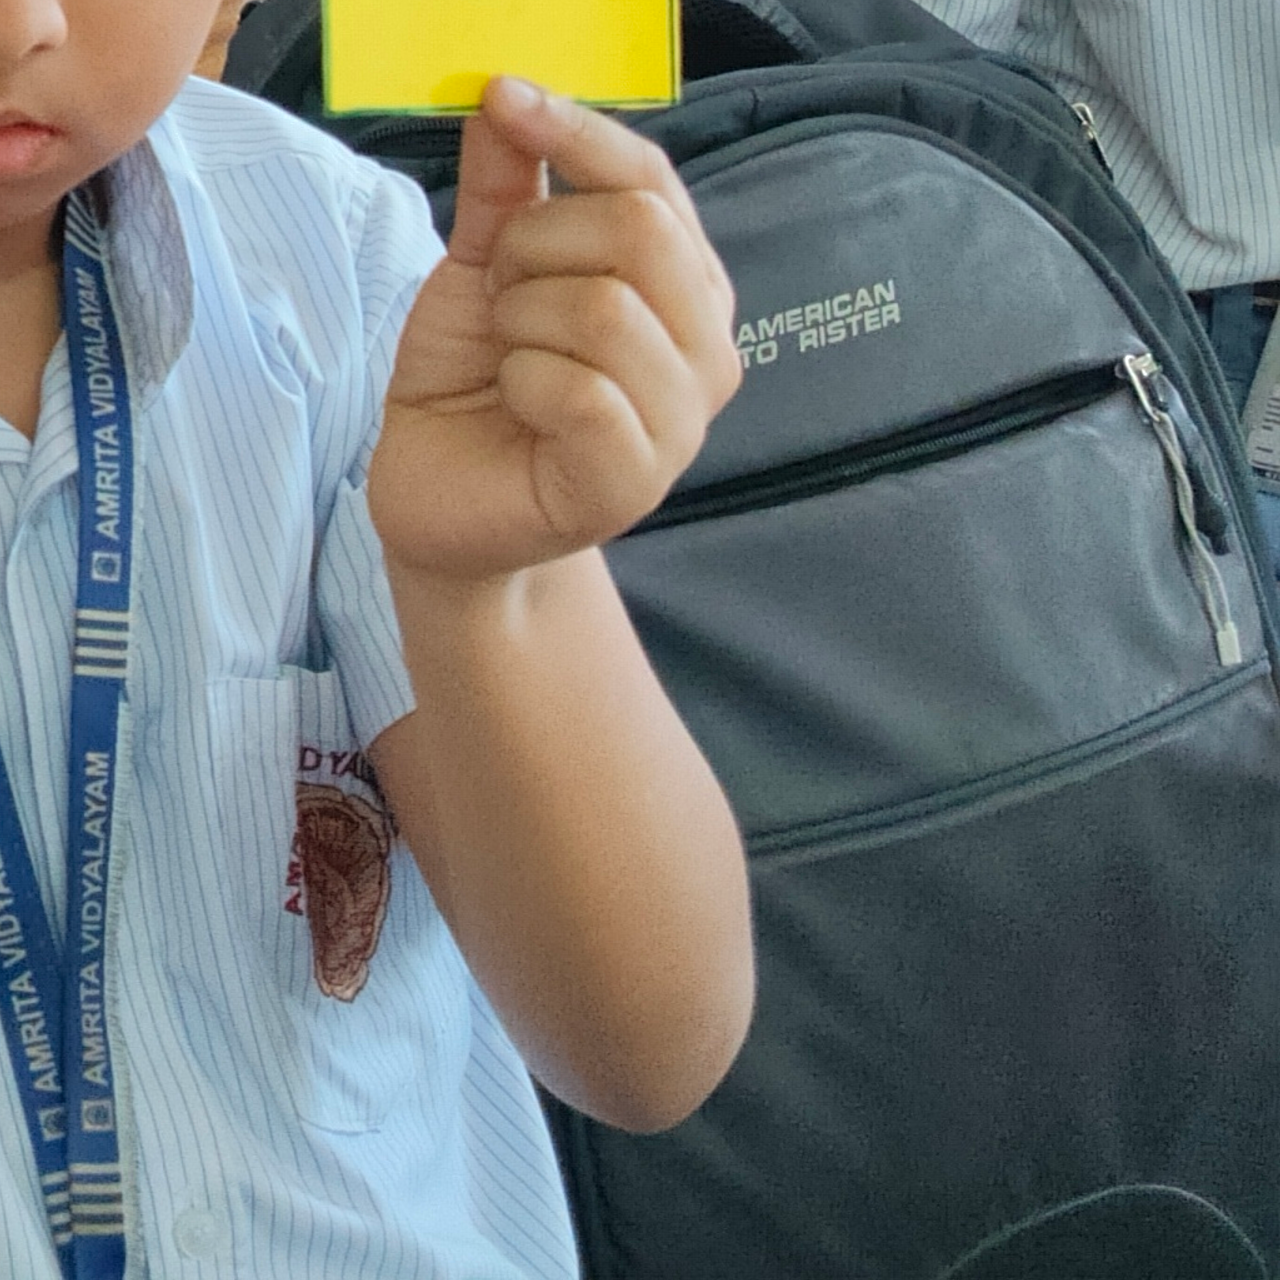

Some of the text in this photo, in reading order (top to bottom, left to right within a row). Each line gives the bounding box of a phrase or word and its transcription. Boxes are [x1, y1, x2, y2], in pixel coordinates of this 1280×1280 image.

[73, 268, 122, 540] AMRITA VIDYALAYAM
[737, 278, 896, 346] AMERICAN
[81, 749, 111, 1087] AMRITA VIDYALAYAM
[13, 960, 60, 1094] AMRITA
